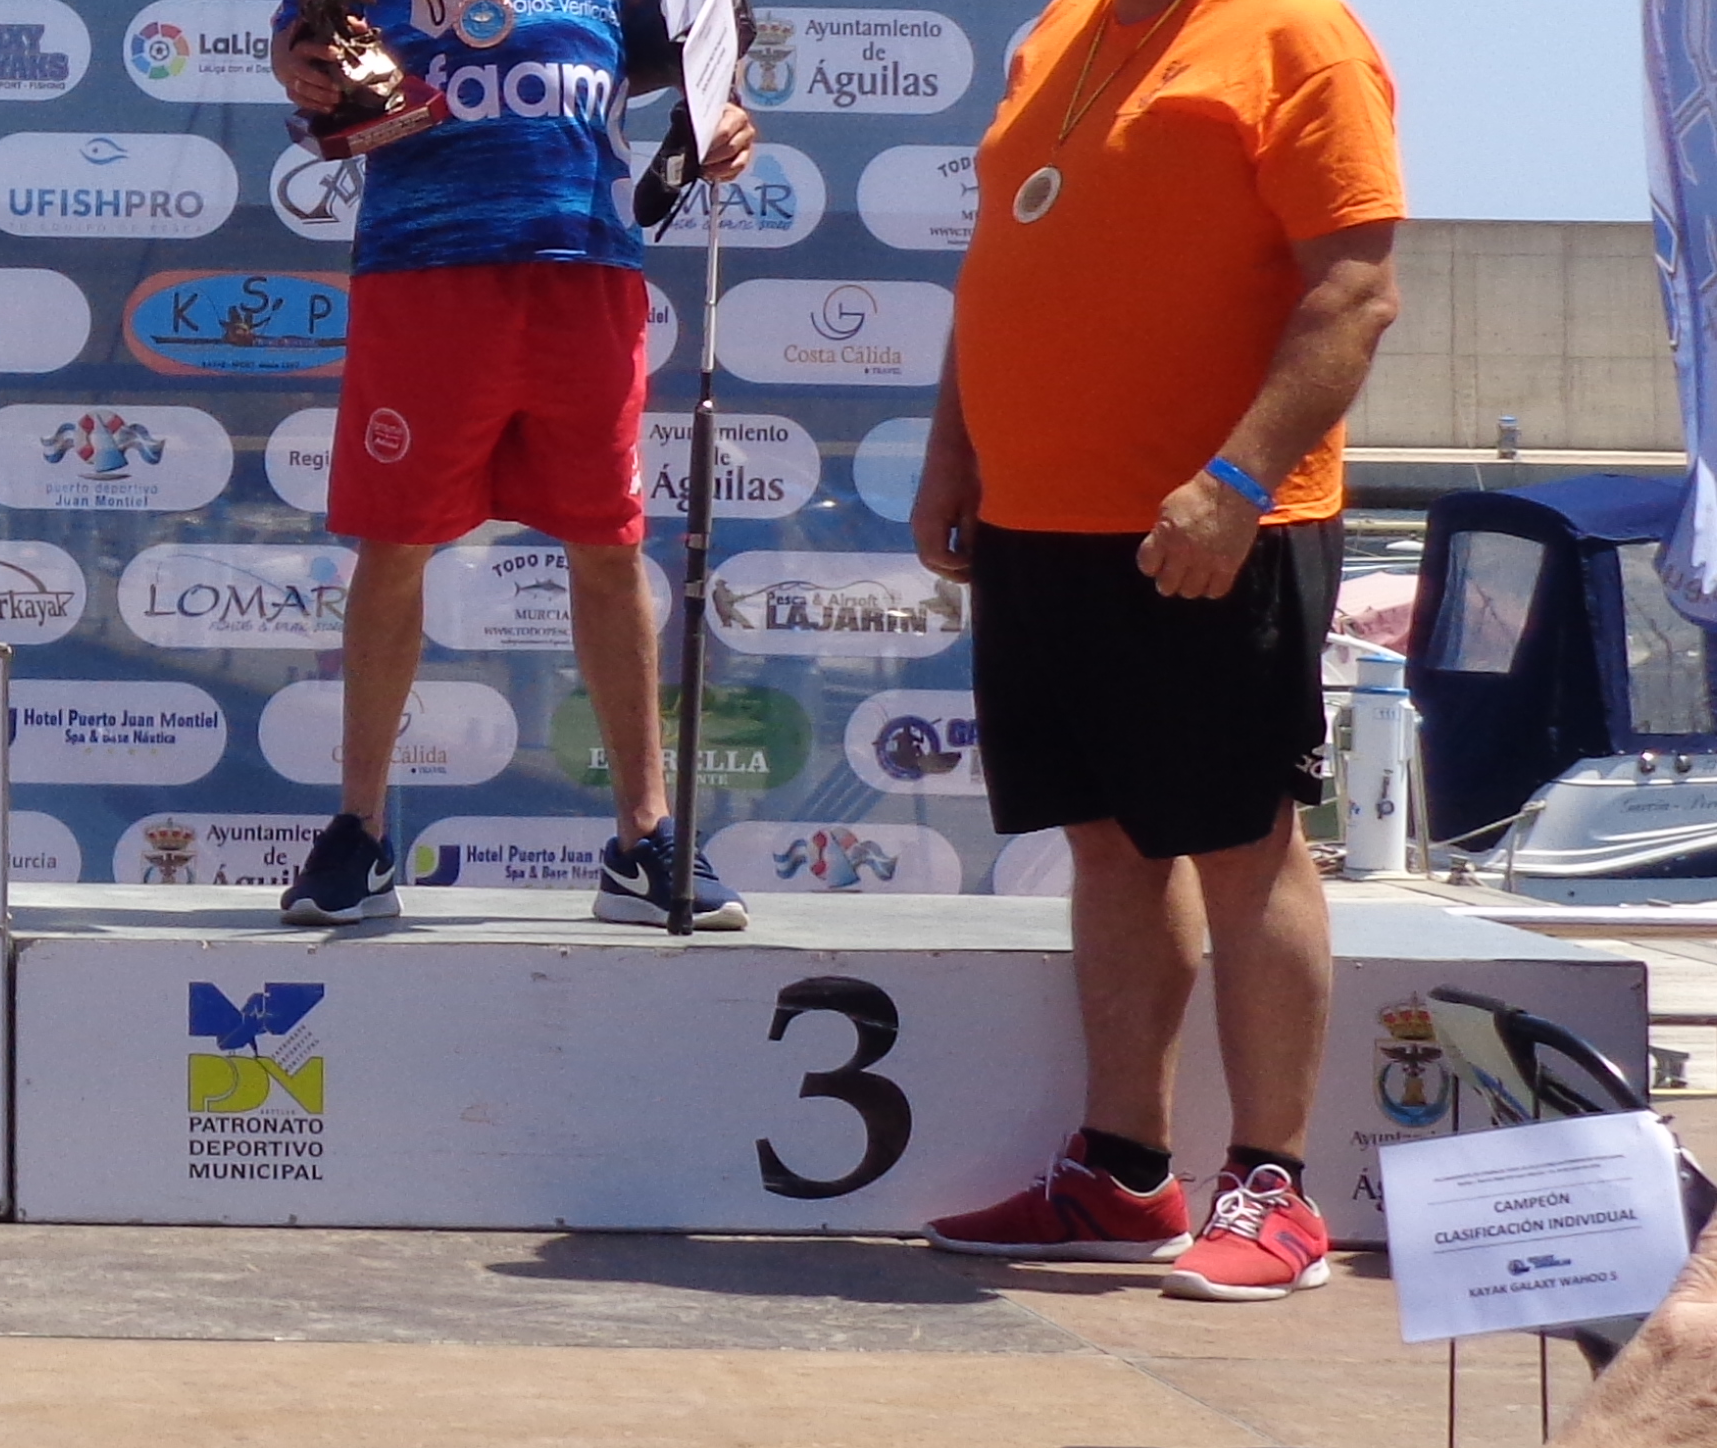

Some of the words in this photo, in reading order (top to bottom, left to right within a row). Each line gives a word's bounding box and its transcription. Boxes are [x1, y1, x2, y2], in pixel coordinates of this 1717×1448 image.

[804, 18, 942, 40] Ayuntamiento
[862, 41, 886, 62] de
[807, 61, 939, 108] Águilas
[9, 188, 204, 219] UFISHPRO
[783, 344, 837, 365] Costa
[841, 345, 902, 365] Cálida
[95, 494, 149, 508] Montiel
[766, 606, 927, 633] LAJARIN
[23, 708, 63, 728] Hotel
[68, 709, 116, 729] Puerto
[121, 710, 155, 729] Juan
[159, 710, 219, 730] Montiel
[466, 846, 504, 864] Hotel
[508, 846, 556, 864] Puerto
[560, 846, 594, 865] Juan
[754, 974, 913, 1200] 3
[188, 1117, 325, 1135] PATRONATO
[188, 1140, 325, 1159] DEPORTIVO
[188, 1163, 324, 1182] MUNICIPAL
[1493, 1192, 1570, 1213] CAMPEÓN
[1434, 1218, 1545, 1245] CLASIFICACIÓN
[1548, 1208, 1637, 1230] INDIVIDUAL
[1468, 1284, 1508, 1298] KAYAK
[1510, 1278, 1557, 1293] GALAXY
[1559, 1273, 1607, 1287] WAHOO
